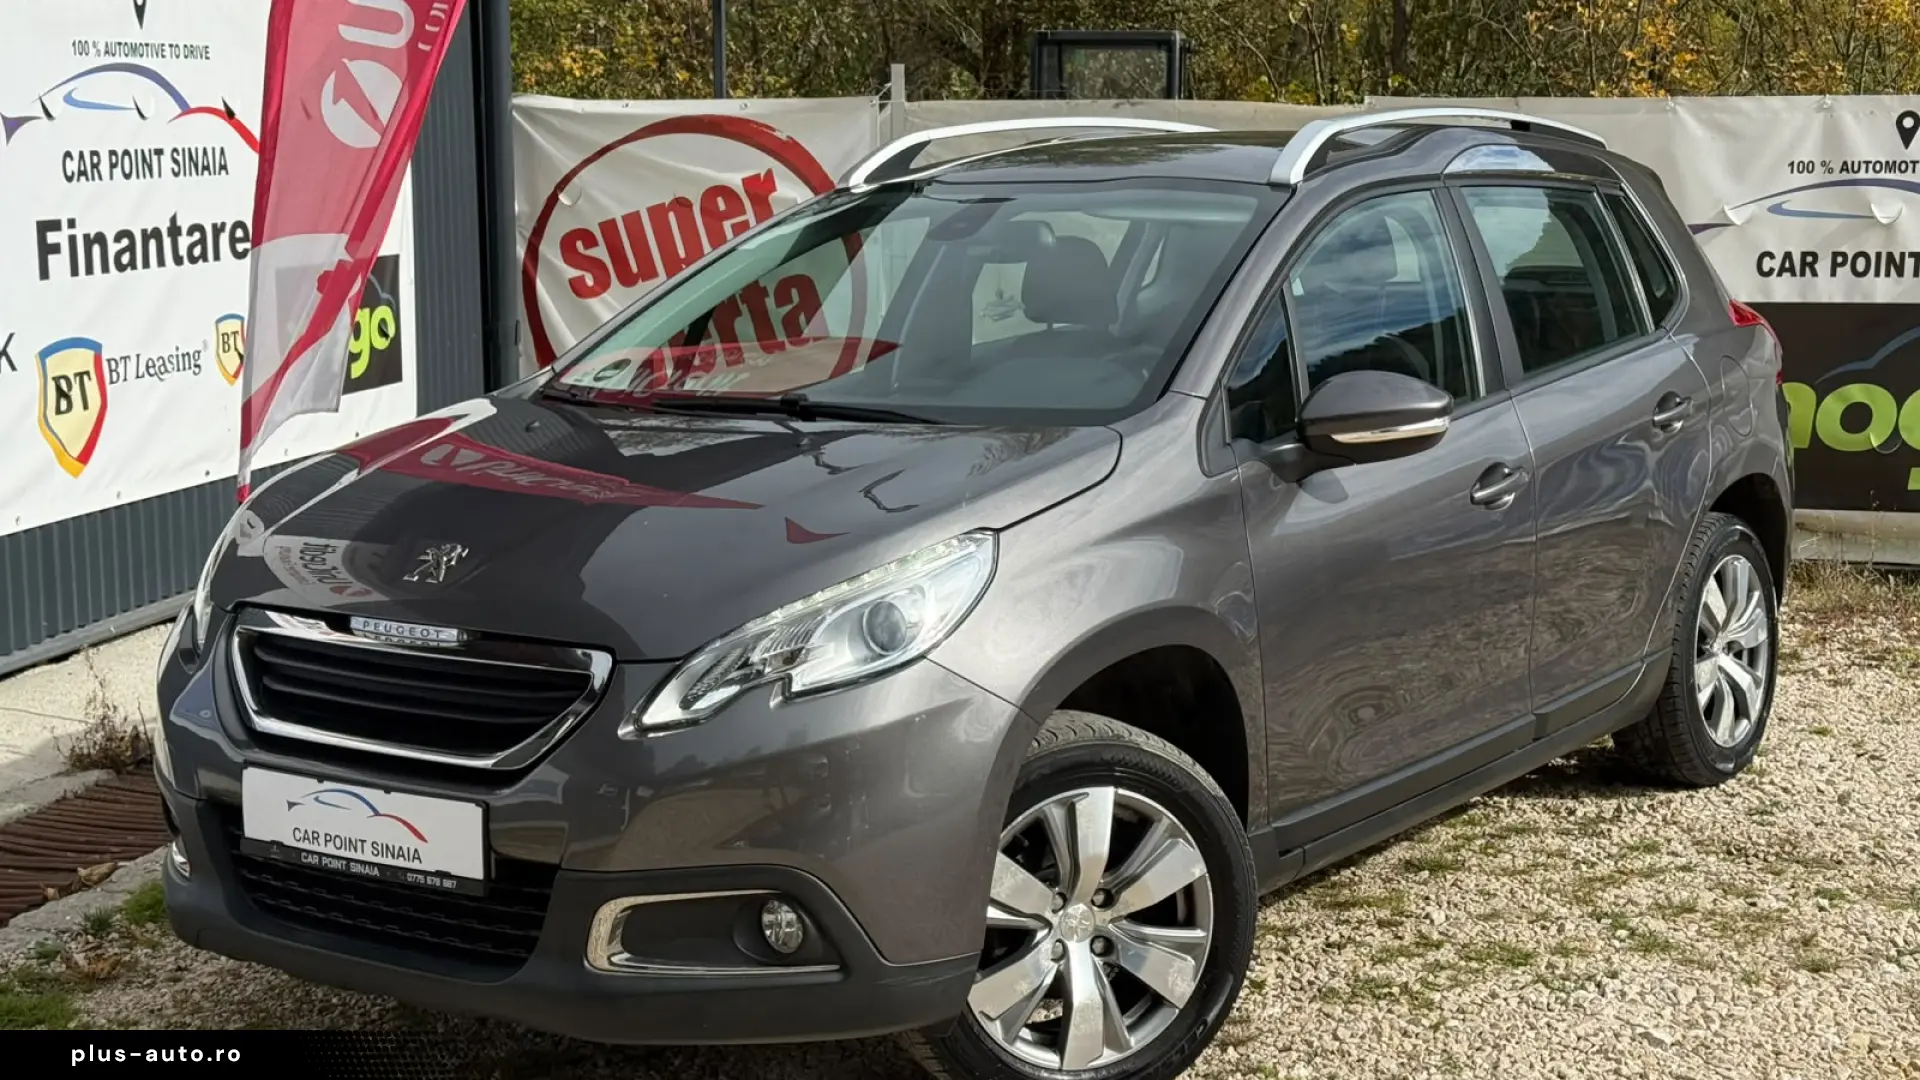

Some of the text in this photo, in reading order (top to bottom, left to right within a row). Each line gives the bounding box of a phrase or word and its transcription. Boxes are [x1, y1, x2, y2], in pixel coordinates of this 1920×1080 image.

[72, 40, 211, 60] 100 % AUTOMOTIVE TO DRIVE
[62, 146, 229, 183] CAR POINT SINAIA
[1787, 160, 1815, 174] 100
[1820, 160, 1834, 174] %
[35, 211, 250, 281] Finantare
[559, 168, 778, 299] super
[1756, 250, 1920, 278] CAR POINT
[221, 330, 240, 354] BT
[105, 345, 201, 385] BT Leasing
[52, 370, 92, 416] BT
[363, 620, 442, 639] PEUGEOT
[292, 827, 422, 865] CAR POINT SINAIA
[301, 852, 380, 877] CAR POINT SINAIA
